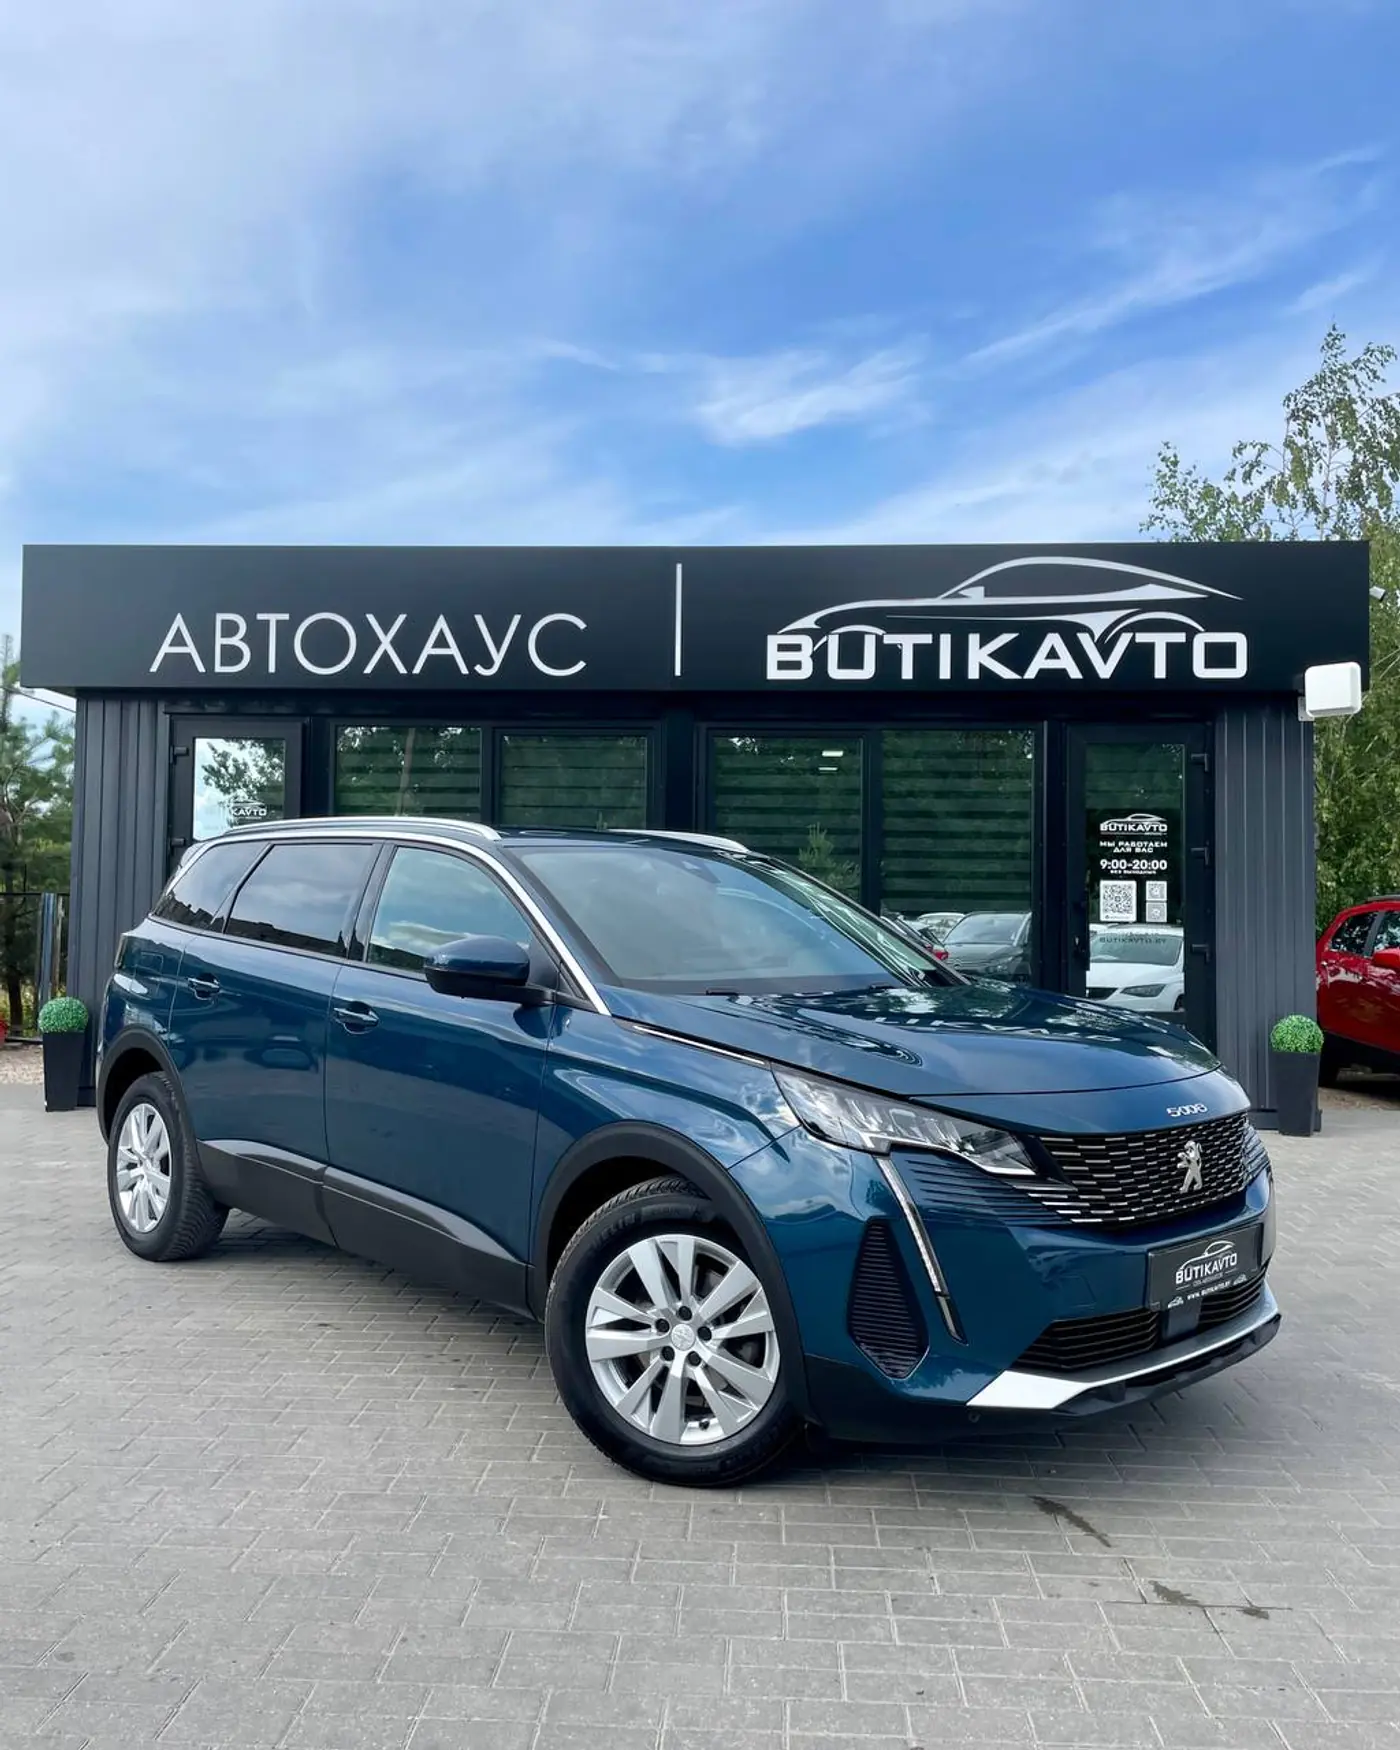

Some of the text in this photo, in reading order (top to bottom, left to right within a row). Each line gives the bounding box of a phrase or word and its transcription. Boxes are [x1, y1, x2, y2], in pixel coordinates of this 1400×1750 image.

[149, 612, 589, 678] АВТОХАУС
[765, 631, 1248, 680] BUTIKAVTO
[1099, 823, 1168, 832] BUTIKAVTO
[1099, 858, 1168, 870] 9:00-20:00
[1166, 1103, 1208, 1118] 5008
[1175, 1252, 1238, 1285] BUTIKAVTO
